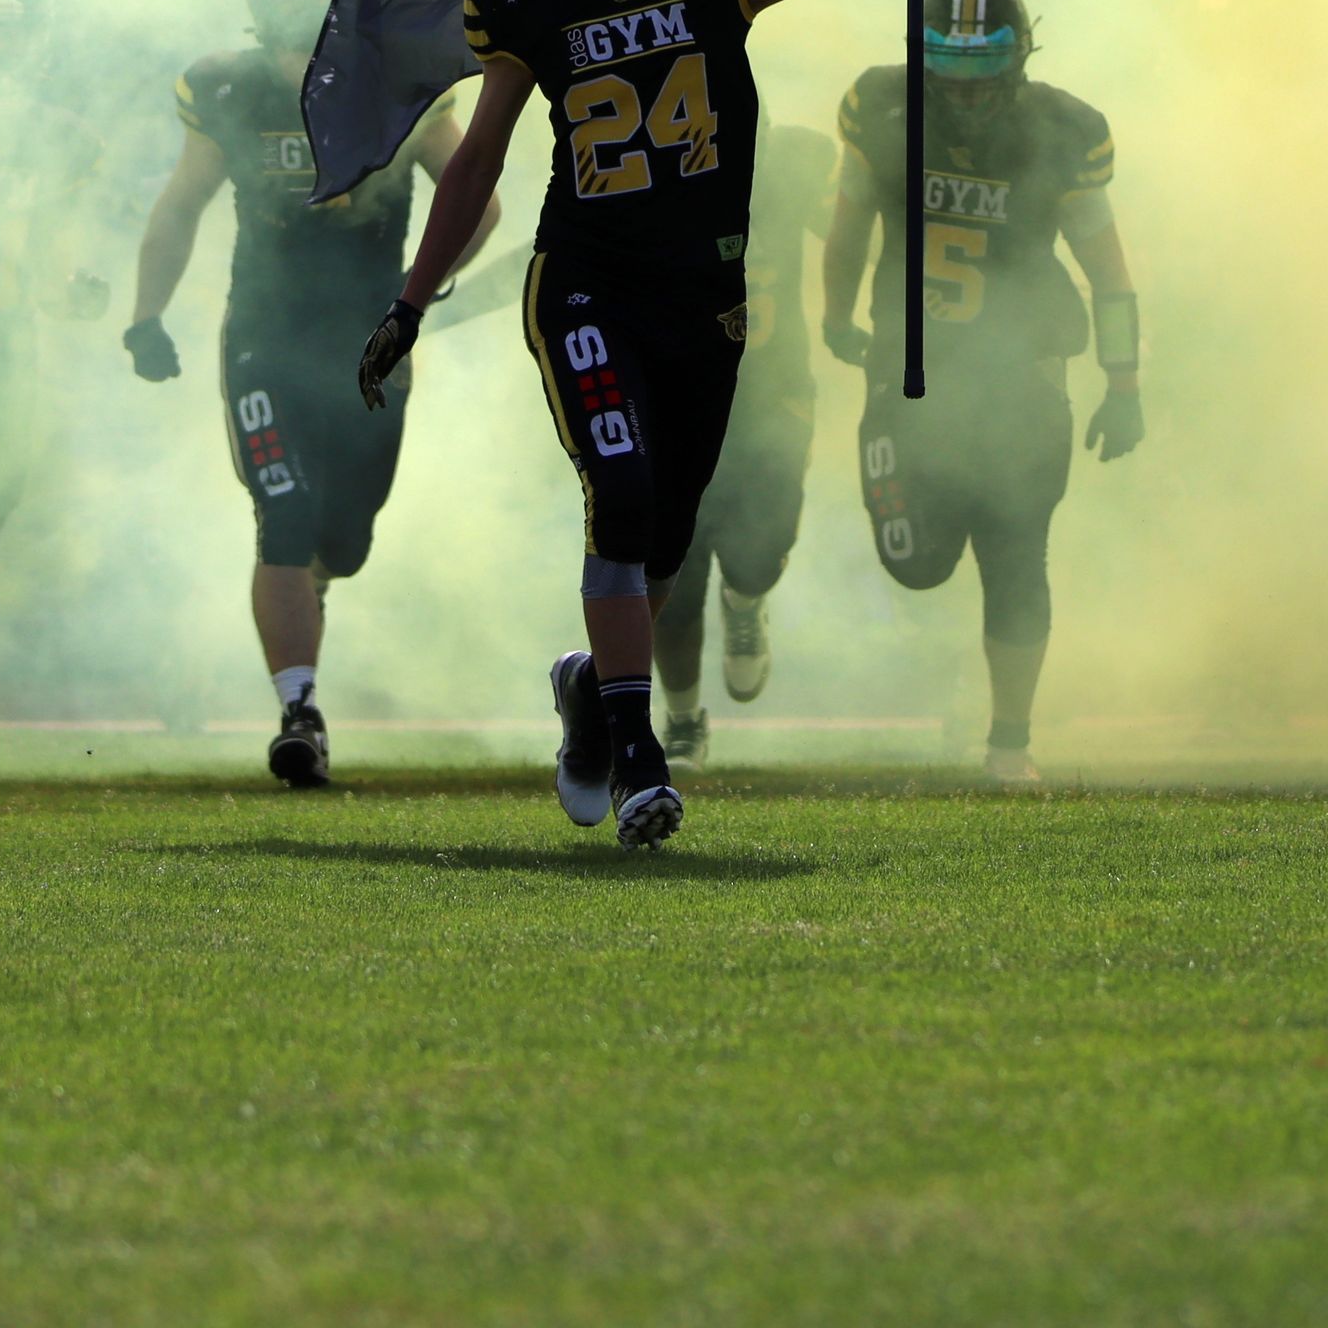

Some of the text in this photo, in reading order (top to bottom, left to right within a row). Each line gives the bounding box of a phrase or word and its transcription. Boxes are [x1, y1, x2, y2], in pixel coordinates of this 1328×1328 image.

[567, 2, 695, 68] das GYM
[564, 52, 720, 199] 24
[924, 173, 1010, 220] GYM
[924, 223, 988, 324] 5
[626, 398, 646, 456] WOHNBAU
